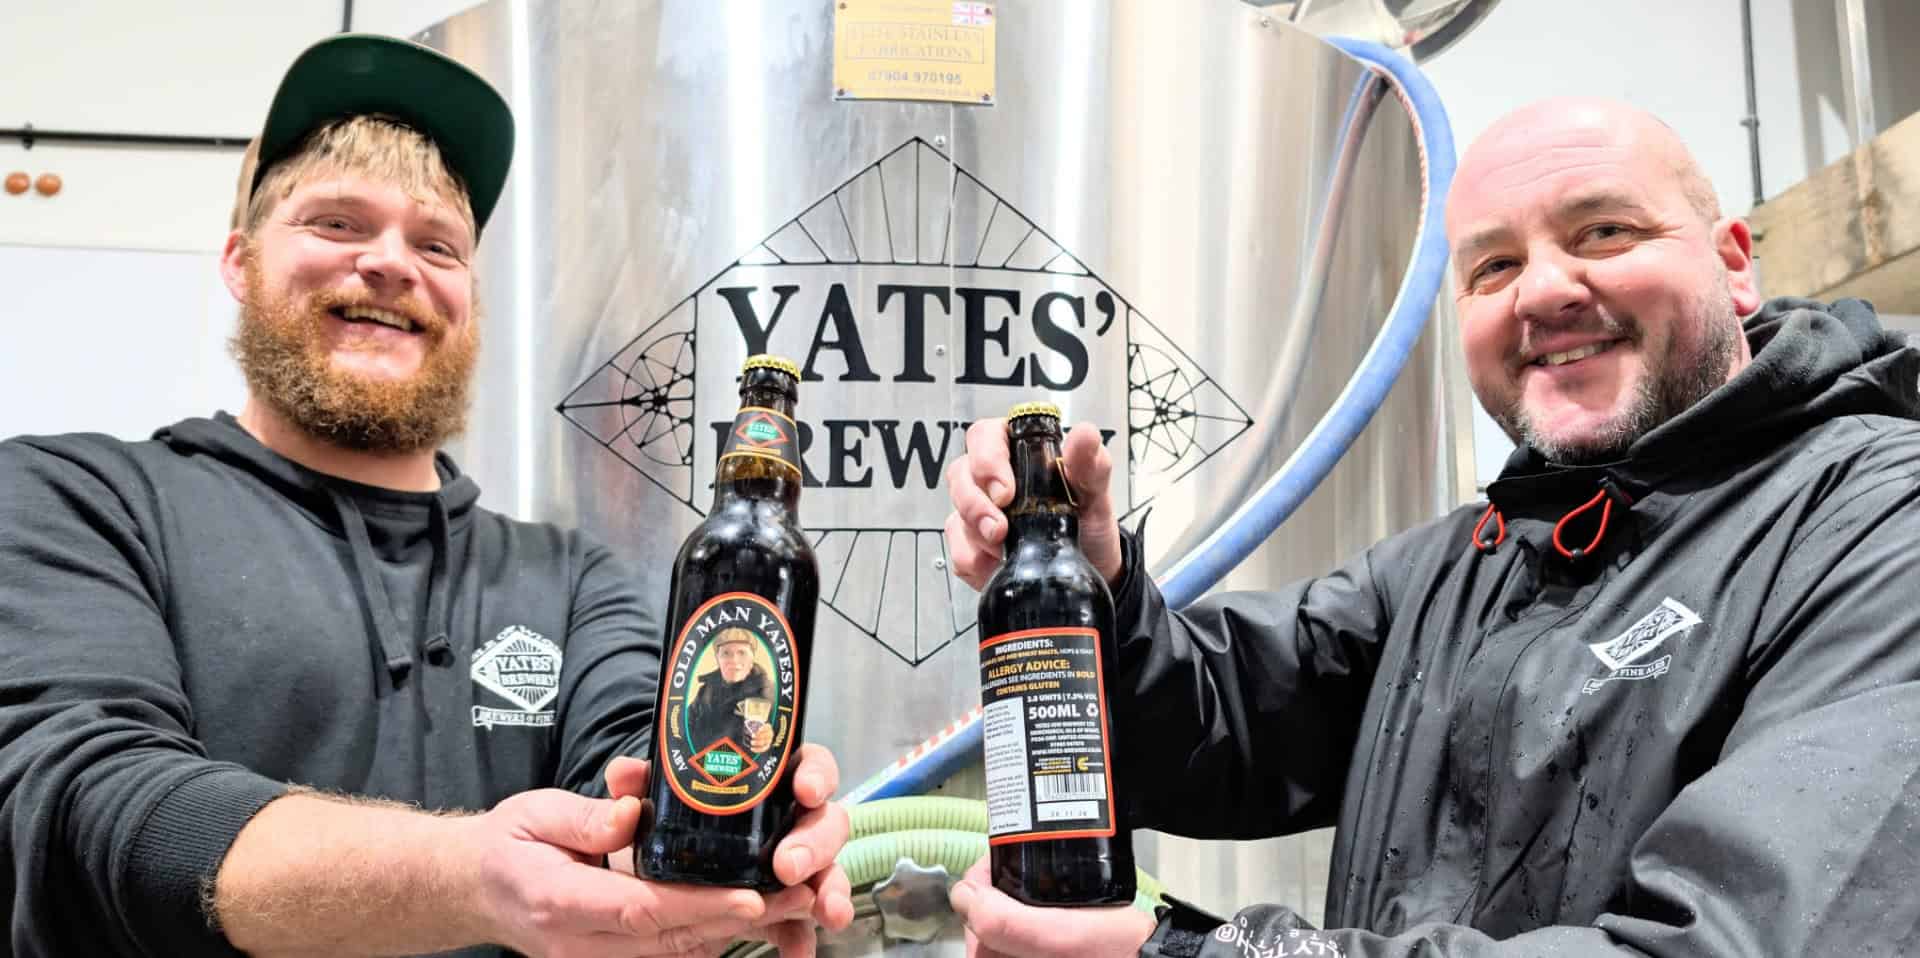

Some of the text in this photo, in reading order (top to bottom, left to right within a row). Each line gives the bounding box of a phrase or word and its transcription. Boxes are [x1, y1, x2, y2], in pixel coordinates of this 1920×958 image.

[672, 606, 793, 701] OLD MAN YATESY
[994, 639, 1054, 655] INGREDIENTS:
[988, 658, 1071, 679] ALLERGY ADVICE:
[1028, 680, 1060, 691] GLUTEN
[1028, 703, 1081, 720] 500ML
[671, 748, 689, 773] ABV
